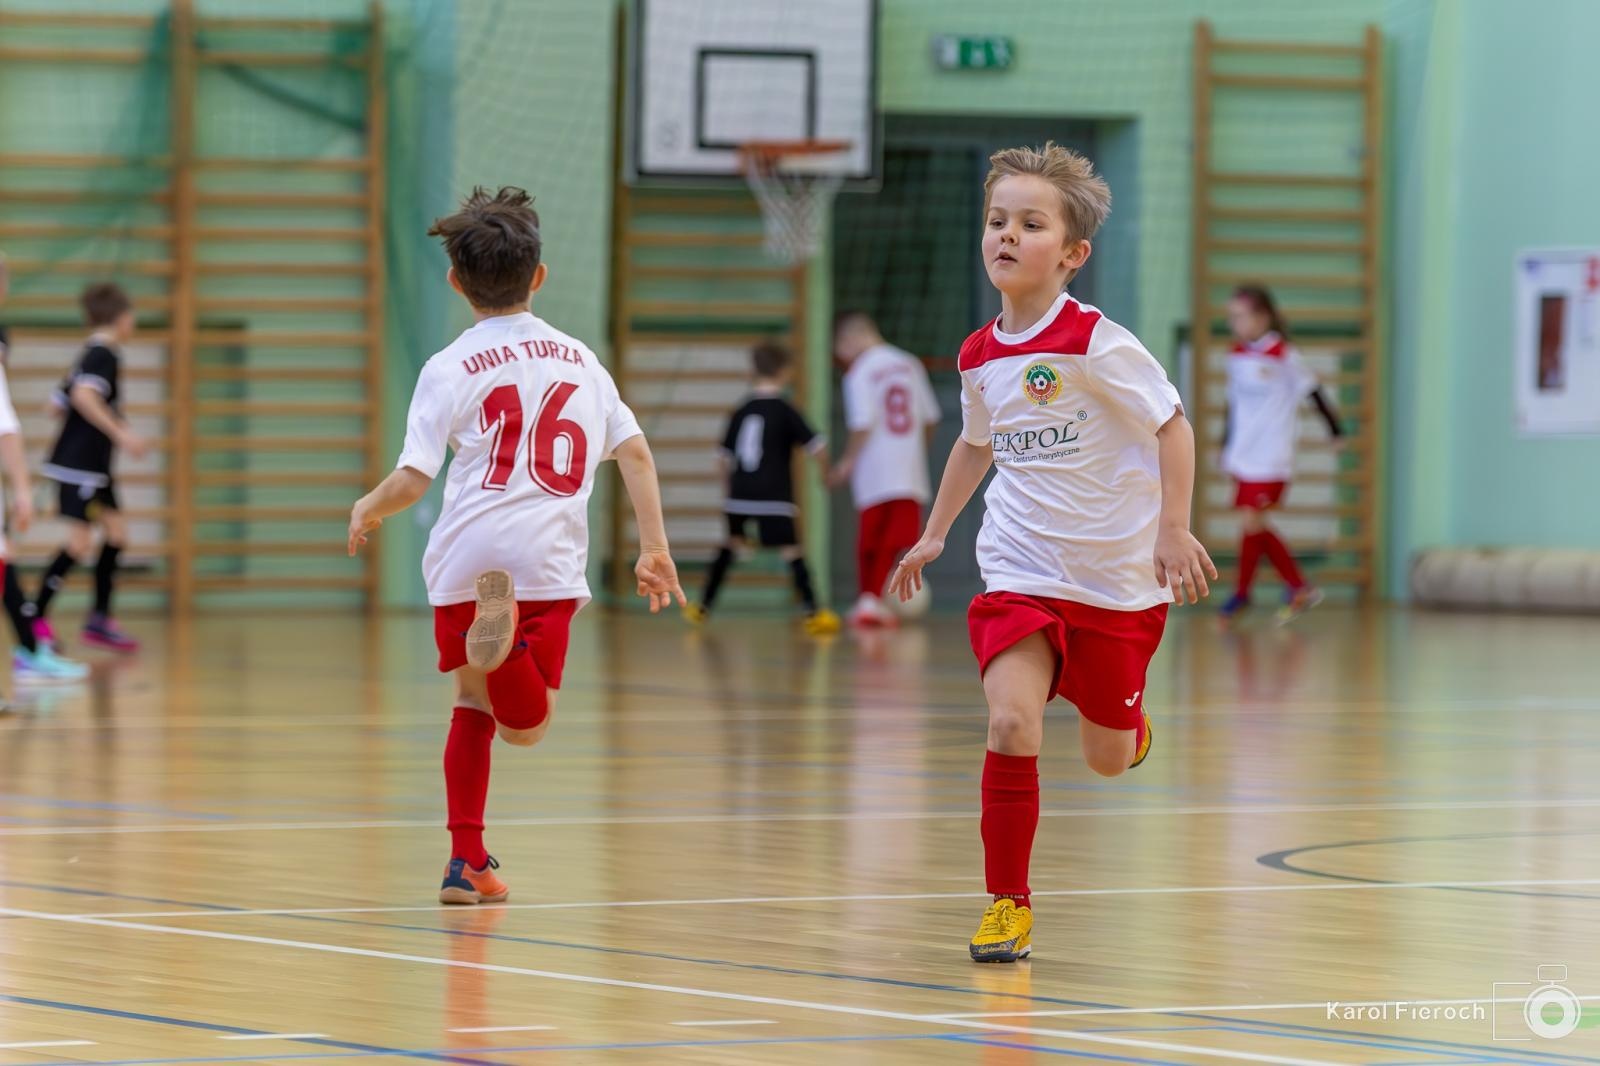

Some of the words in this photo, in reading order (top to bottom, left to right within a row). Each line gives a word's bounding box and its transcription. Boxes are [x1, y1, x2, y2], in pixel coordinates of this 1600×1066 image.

[462, 345, 518, 376] UNIA
[519, 340, 585, 368] TURZA
[480, 380, 588, 497] 16
